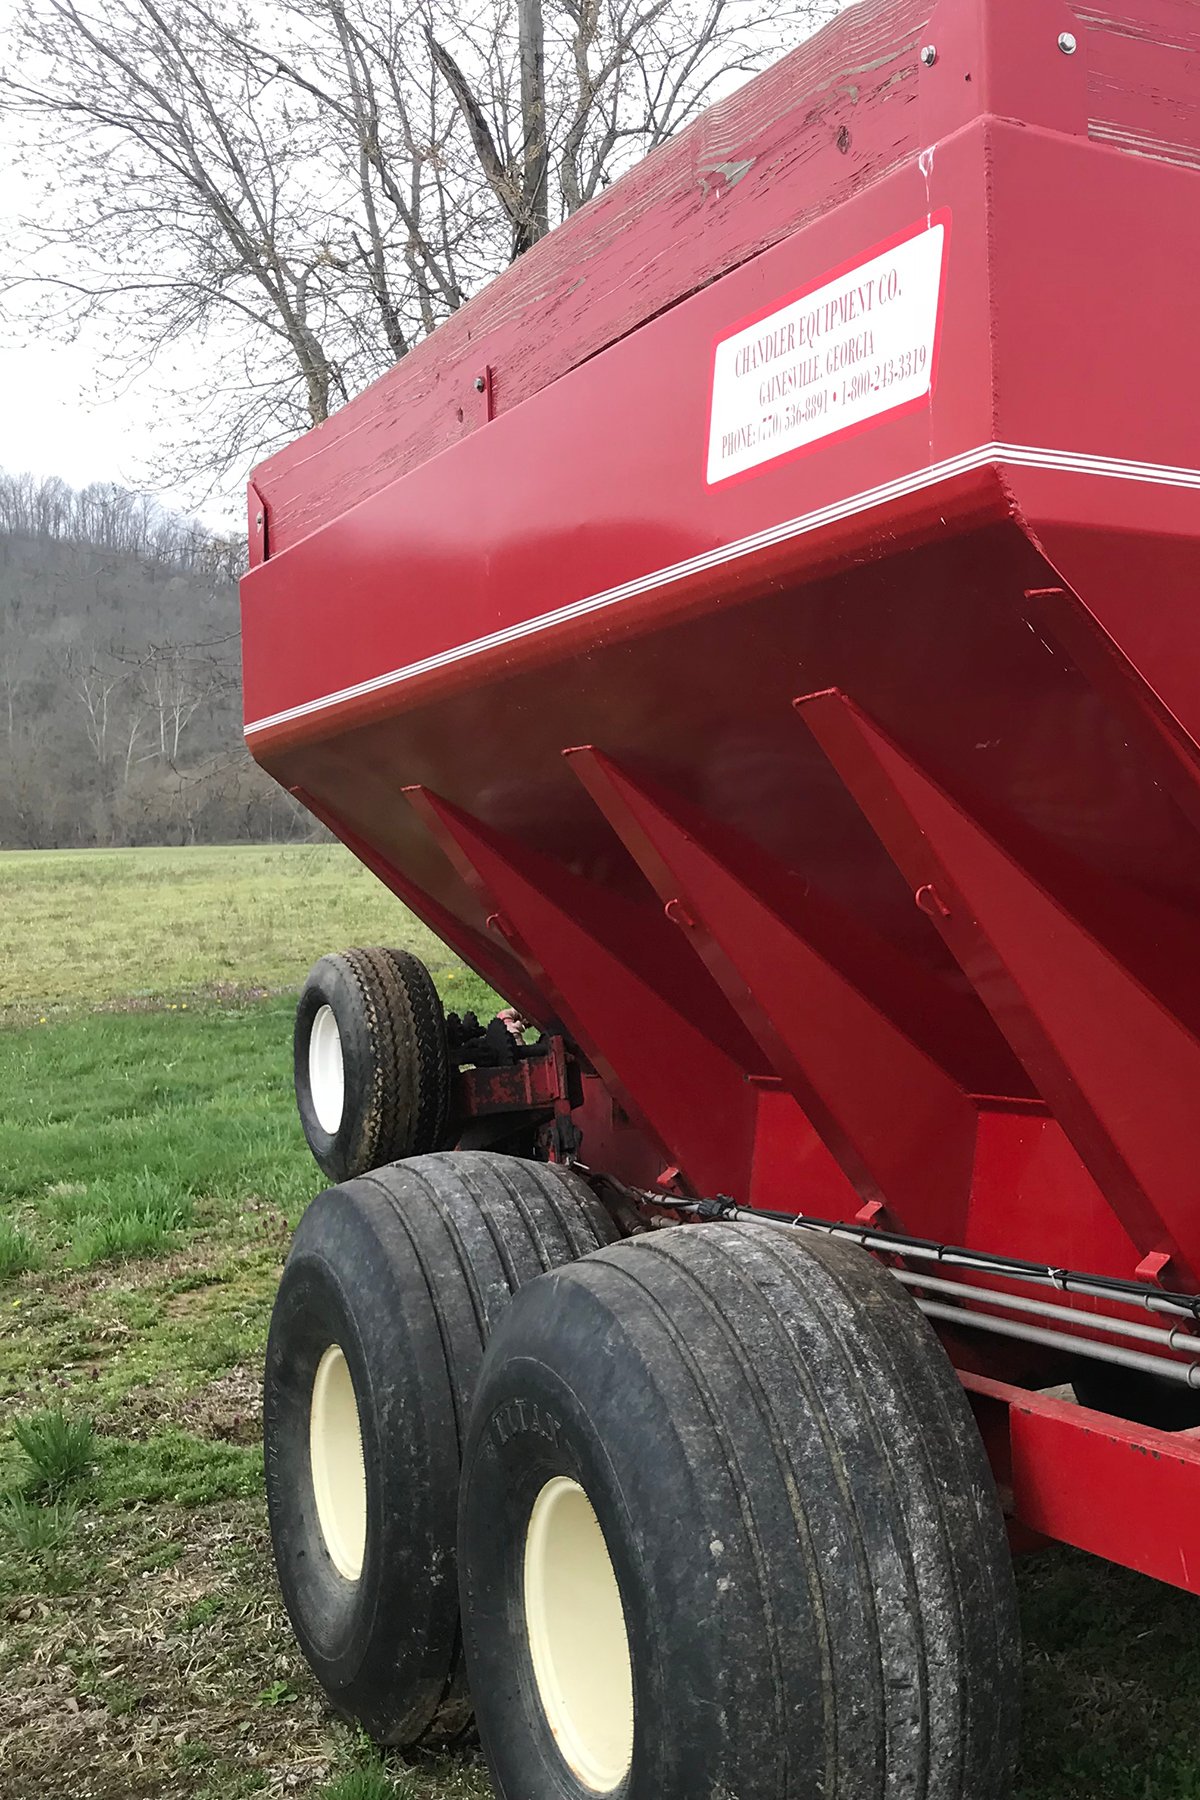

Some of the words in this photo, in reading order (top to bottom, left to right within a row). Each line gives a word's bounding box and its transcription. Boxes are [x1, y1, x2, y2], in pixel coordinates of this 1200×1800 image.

[735, 322, 796, 378] CHANDLER
[799, 280, 875, 349] EQUIPMENT
[878, 268, 902, 306] CO.
[826, 330, 875, 376] GEORGIA
[722, 423, 756, 459] PHONE:
[784, 390, 828, 431] 536-8891
[841, 344, 926, 406] 1-800-243-3319
